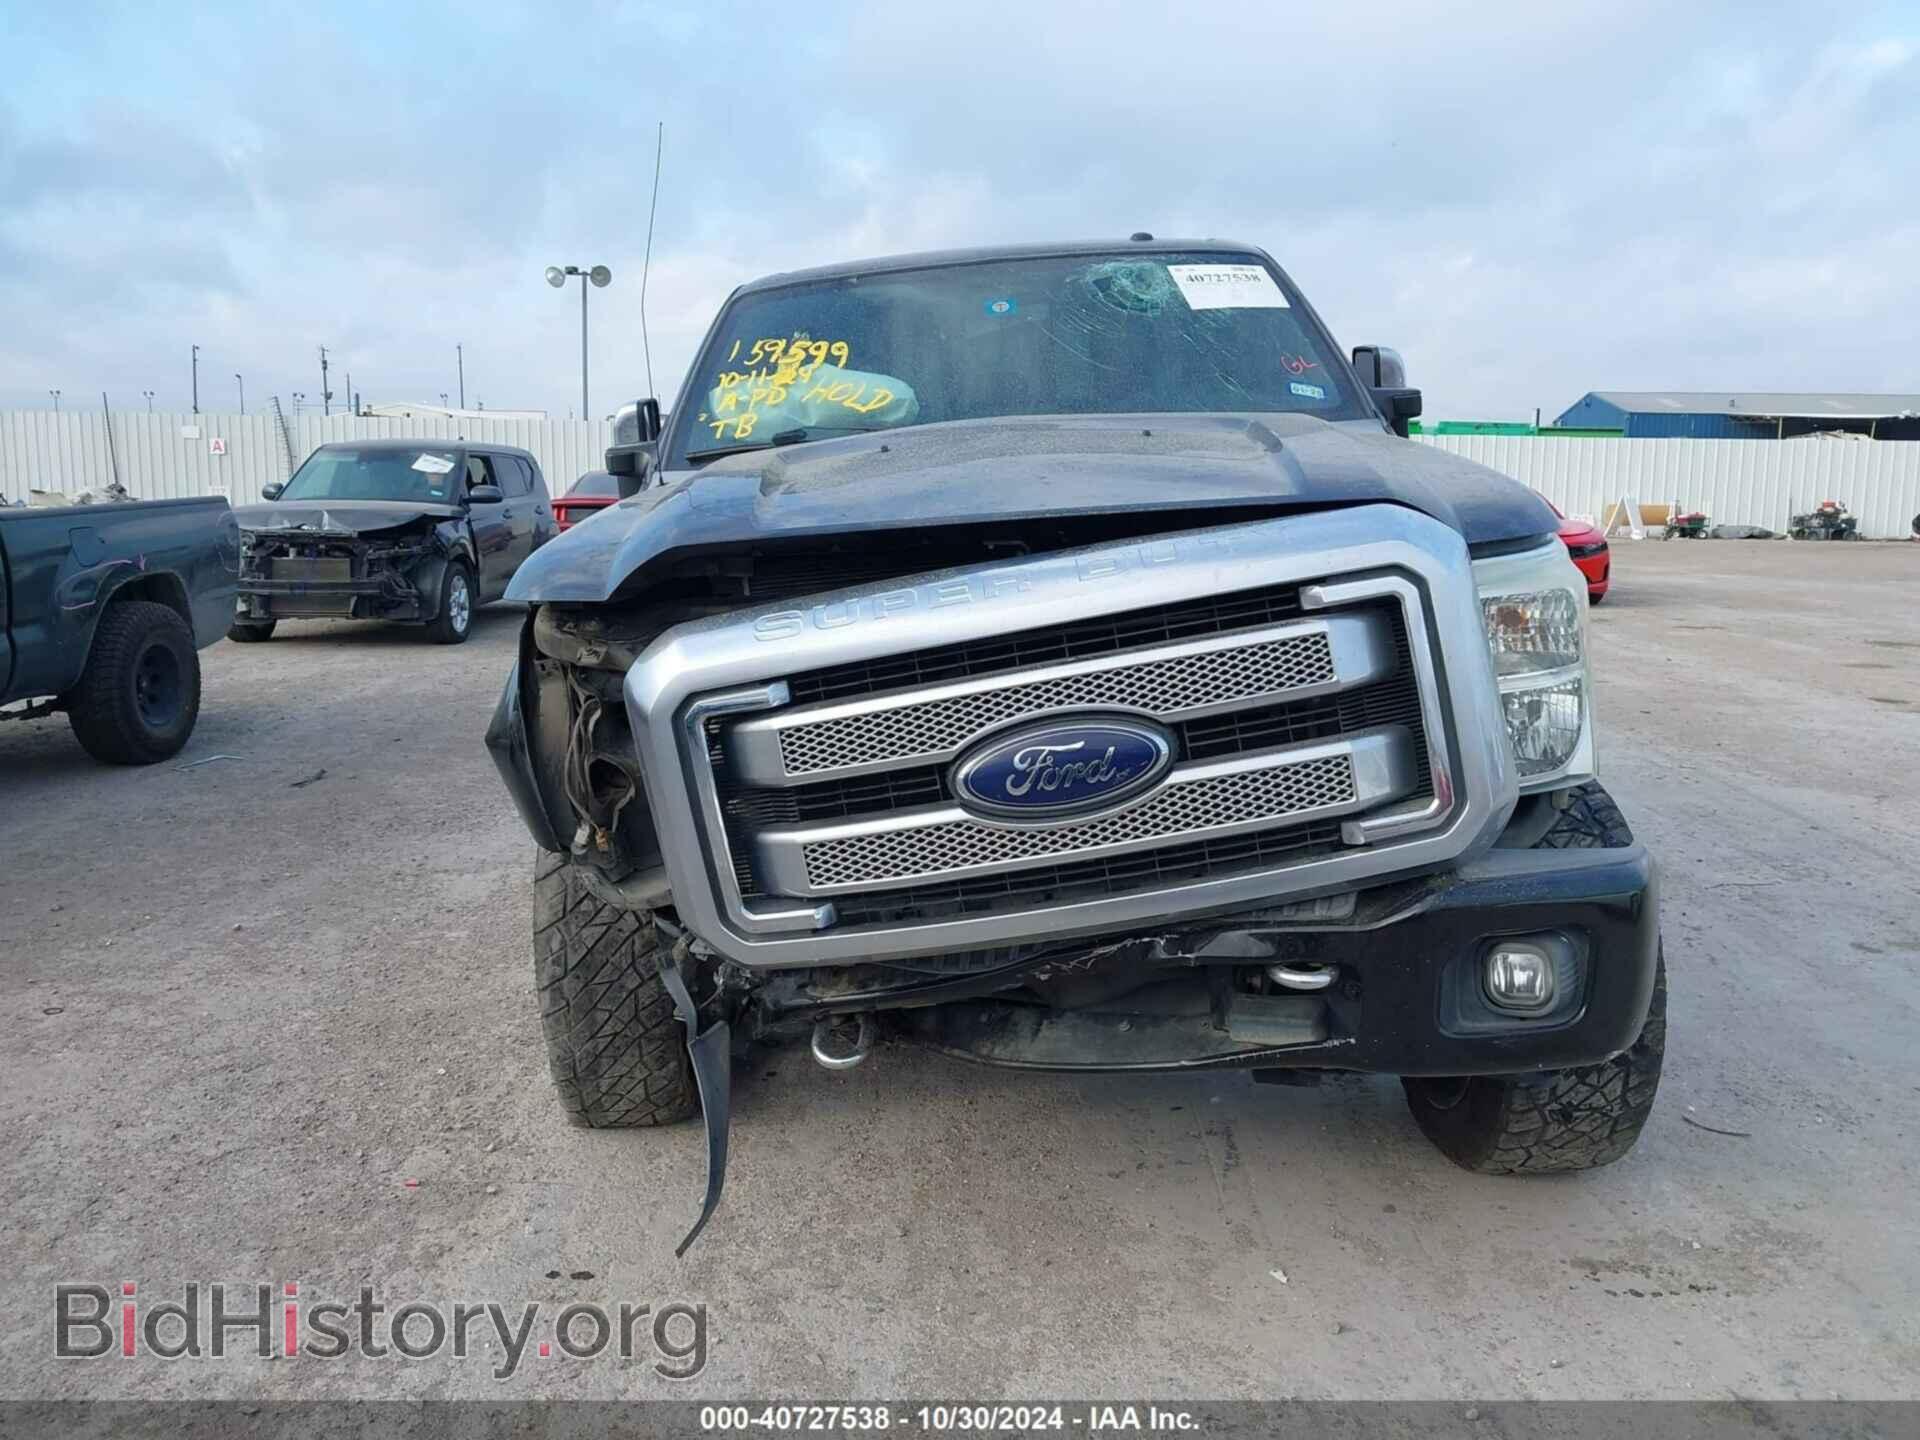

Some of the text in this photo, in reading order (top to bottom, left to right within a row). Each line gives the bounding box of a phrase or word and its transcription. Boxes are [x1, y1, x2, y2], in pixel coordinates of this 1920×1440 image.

[1185, 273, 1262, 283] 40727538
[803, 380, 895, 413] HOLD
[212, 439, 224, 452] A
[752, 572, 1032, 642] SUPER
[1005, 740, 1131, 796] Ford
